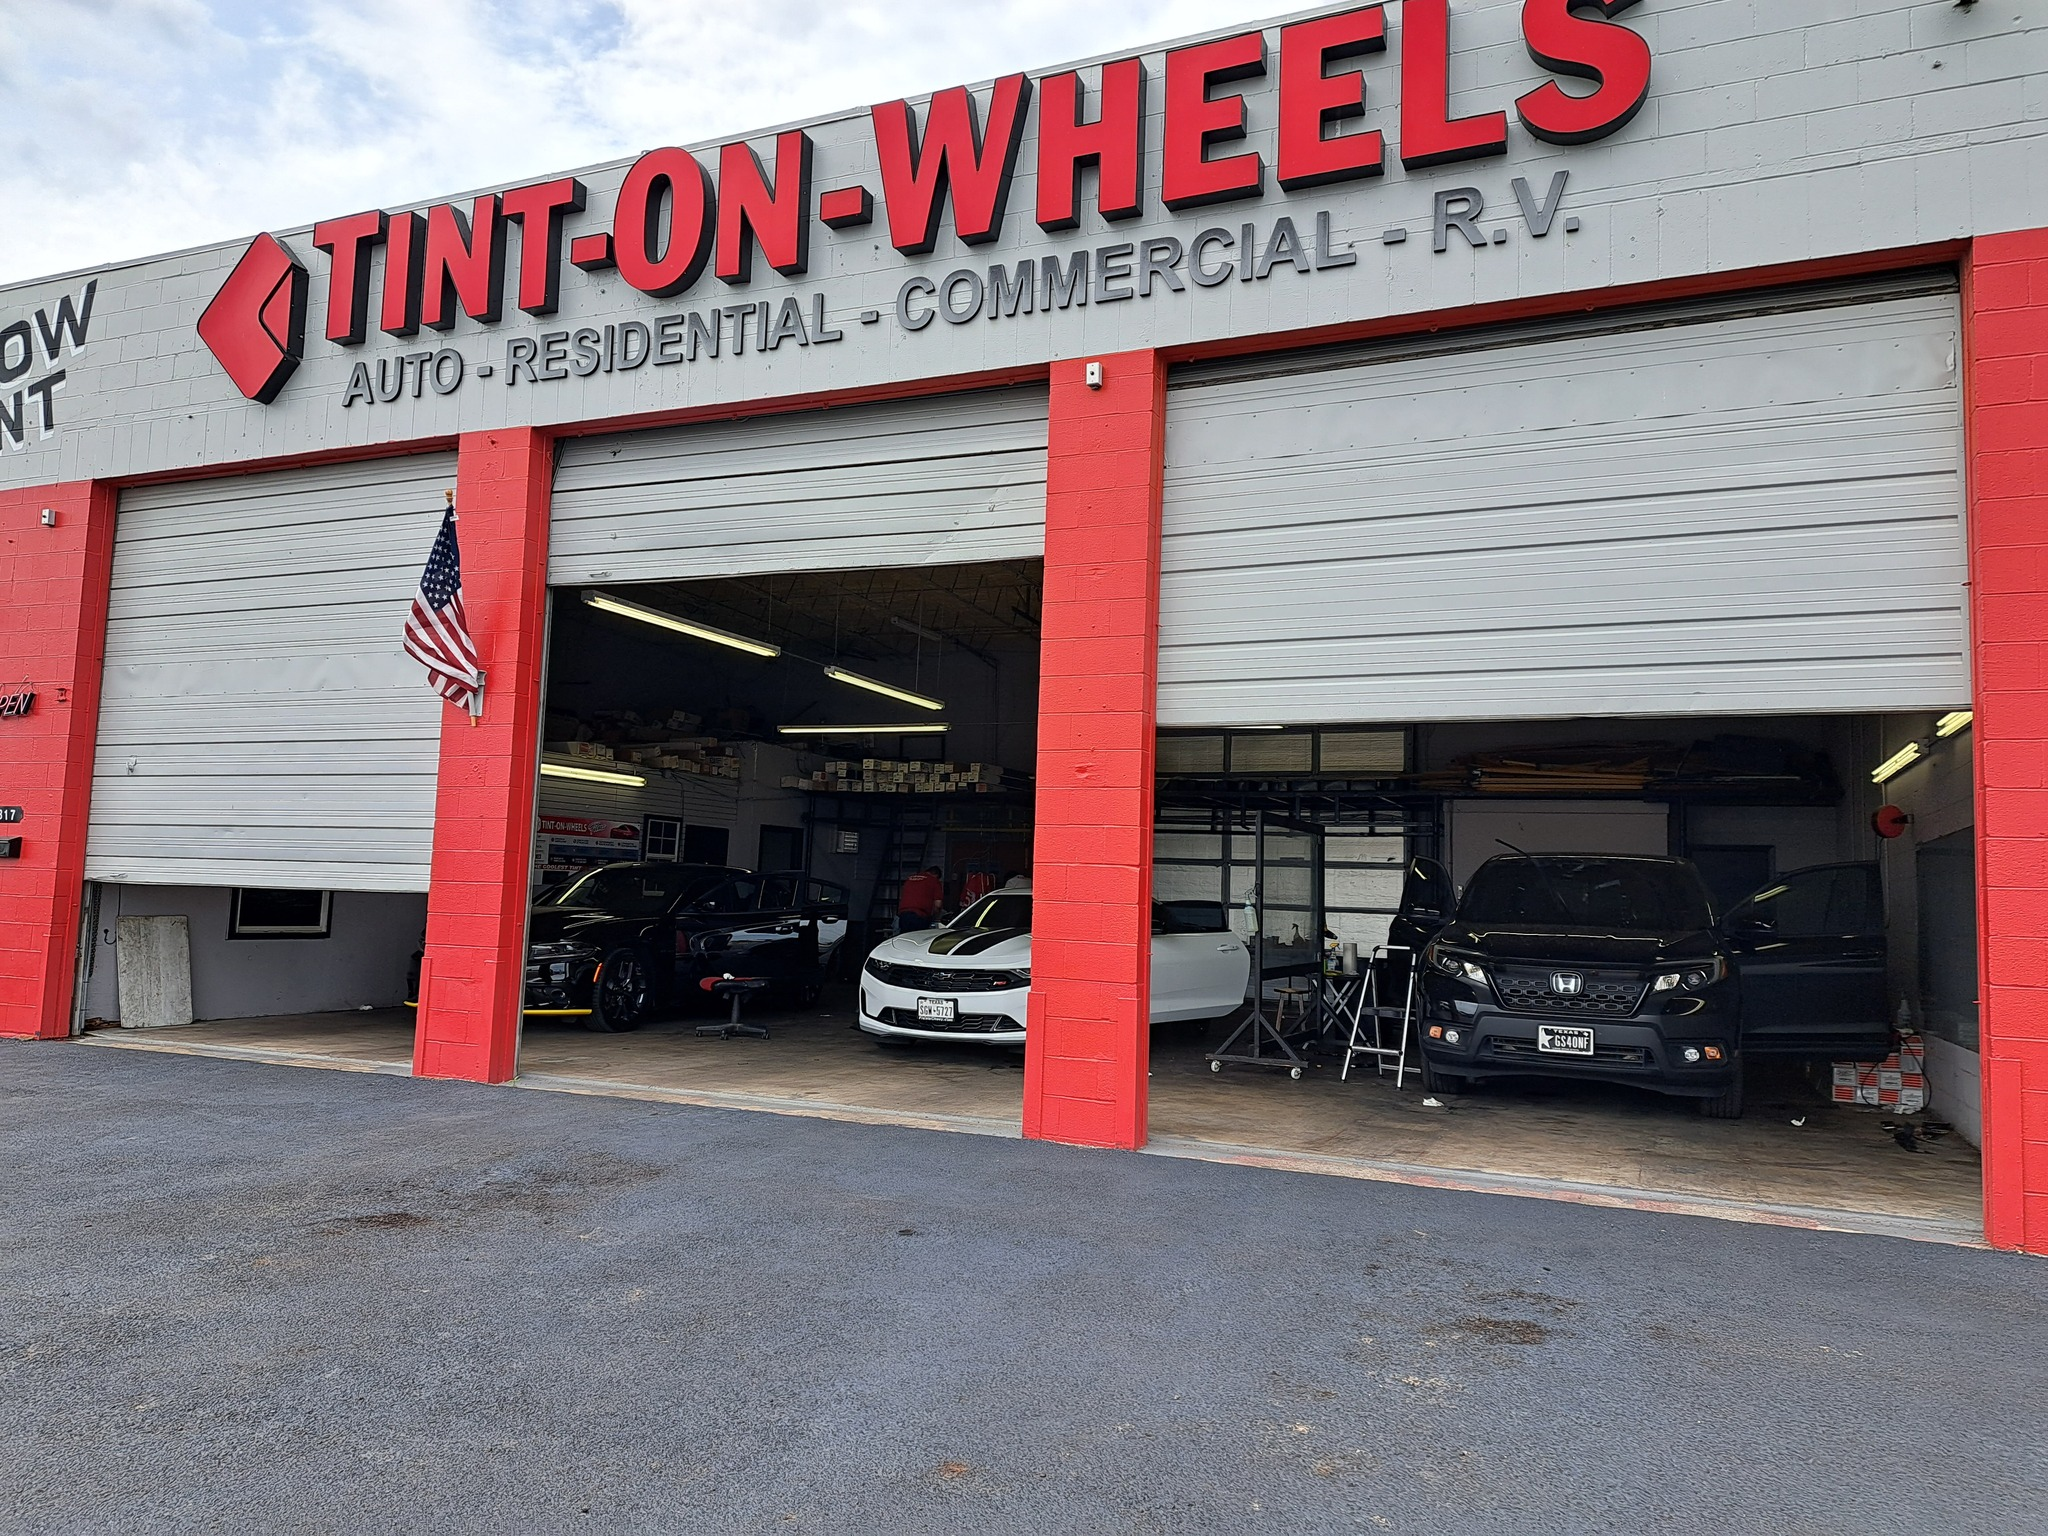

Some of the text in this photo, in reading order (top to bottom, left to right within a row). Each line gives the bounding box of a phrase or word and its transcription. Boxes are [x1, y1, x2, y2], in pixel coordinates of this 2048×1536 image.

[312, 0, 1653, 346] TINT-ON-WHEELS
[0, 278, 98, 384] OW
[341, 347, 464, 408] AUTO
[503, 292, 844, 387] RESIDENTIAL
[895, 210, 1358, 333] COMMERCIAL
[1432, 168, 1581, 255] R.V.
[542, 821, 587, 832] TINT-ON-WHEELS
